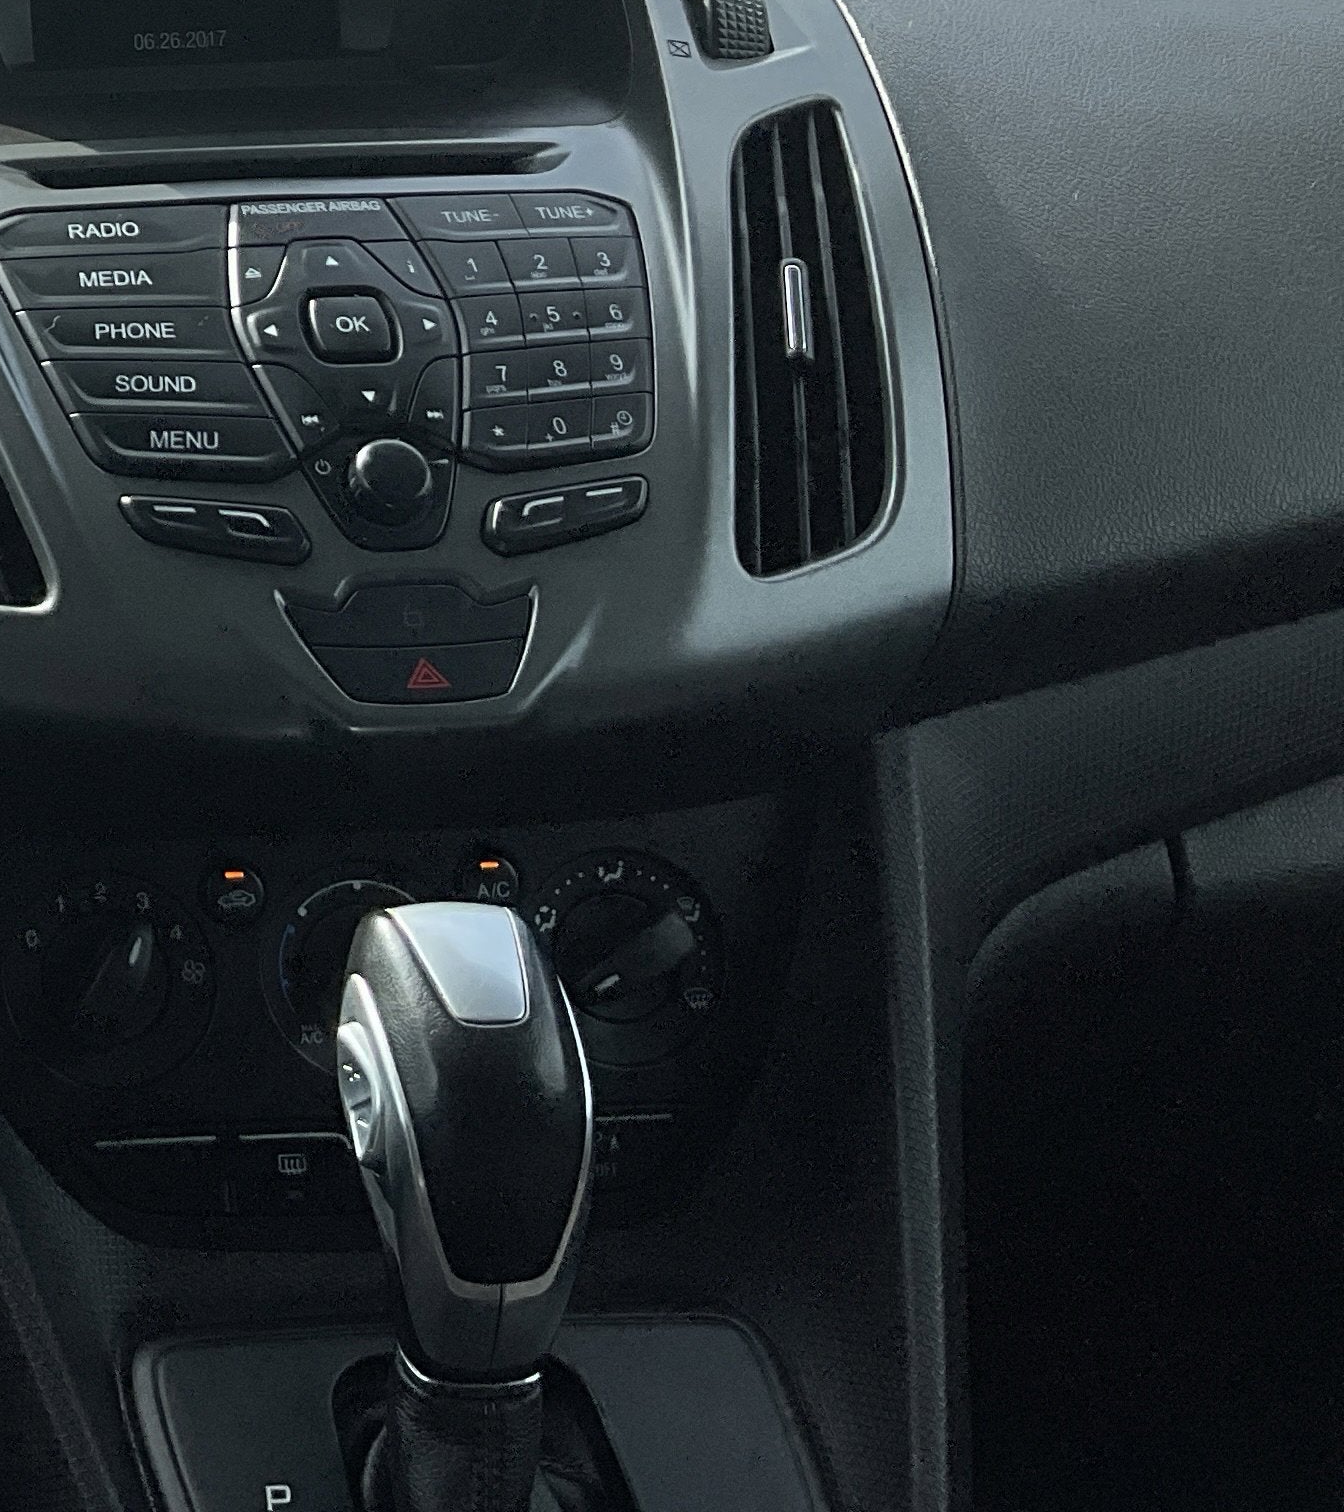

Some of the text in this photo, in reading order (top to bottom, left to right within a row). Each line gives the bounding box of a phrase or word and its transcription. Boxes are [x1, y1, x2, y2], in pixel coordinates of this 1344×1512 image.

[133, 30, 227, 51] 06.26.2017
[241, 200, 382, 215] PASSENGER AIRBAG
[68, 221, 139, 239] RADIO
[466, 251, 611, 273] 1 2 3
[79, 269, 153, 288] MEDIA
[485, 303, 624, 326] 4 5 6
[95, 322, 176, 340] PHONE
[335, 316, 371, 333] OK
[495, 354, 623, 383] 7 8 9
[115, 375, 197, 393] SOUND
[552, 416, 568, 436] 0
[150, 431, 219, 450] MENU
[477, 881, 511, 901] A/C
[264, 1484, 291, 1512] P
